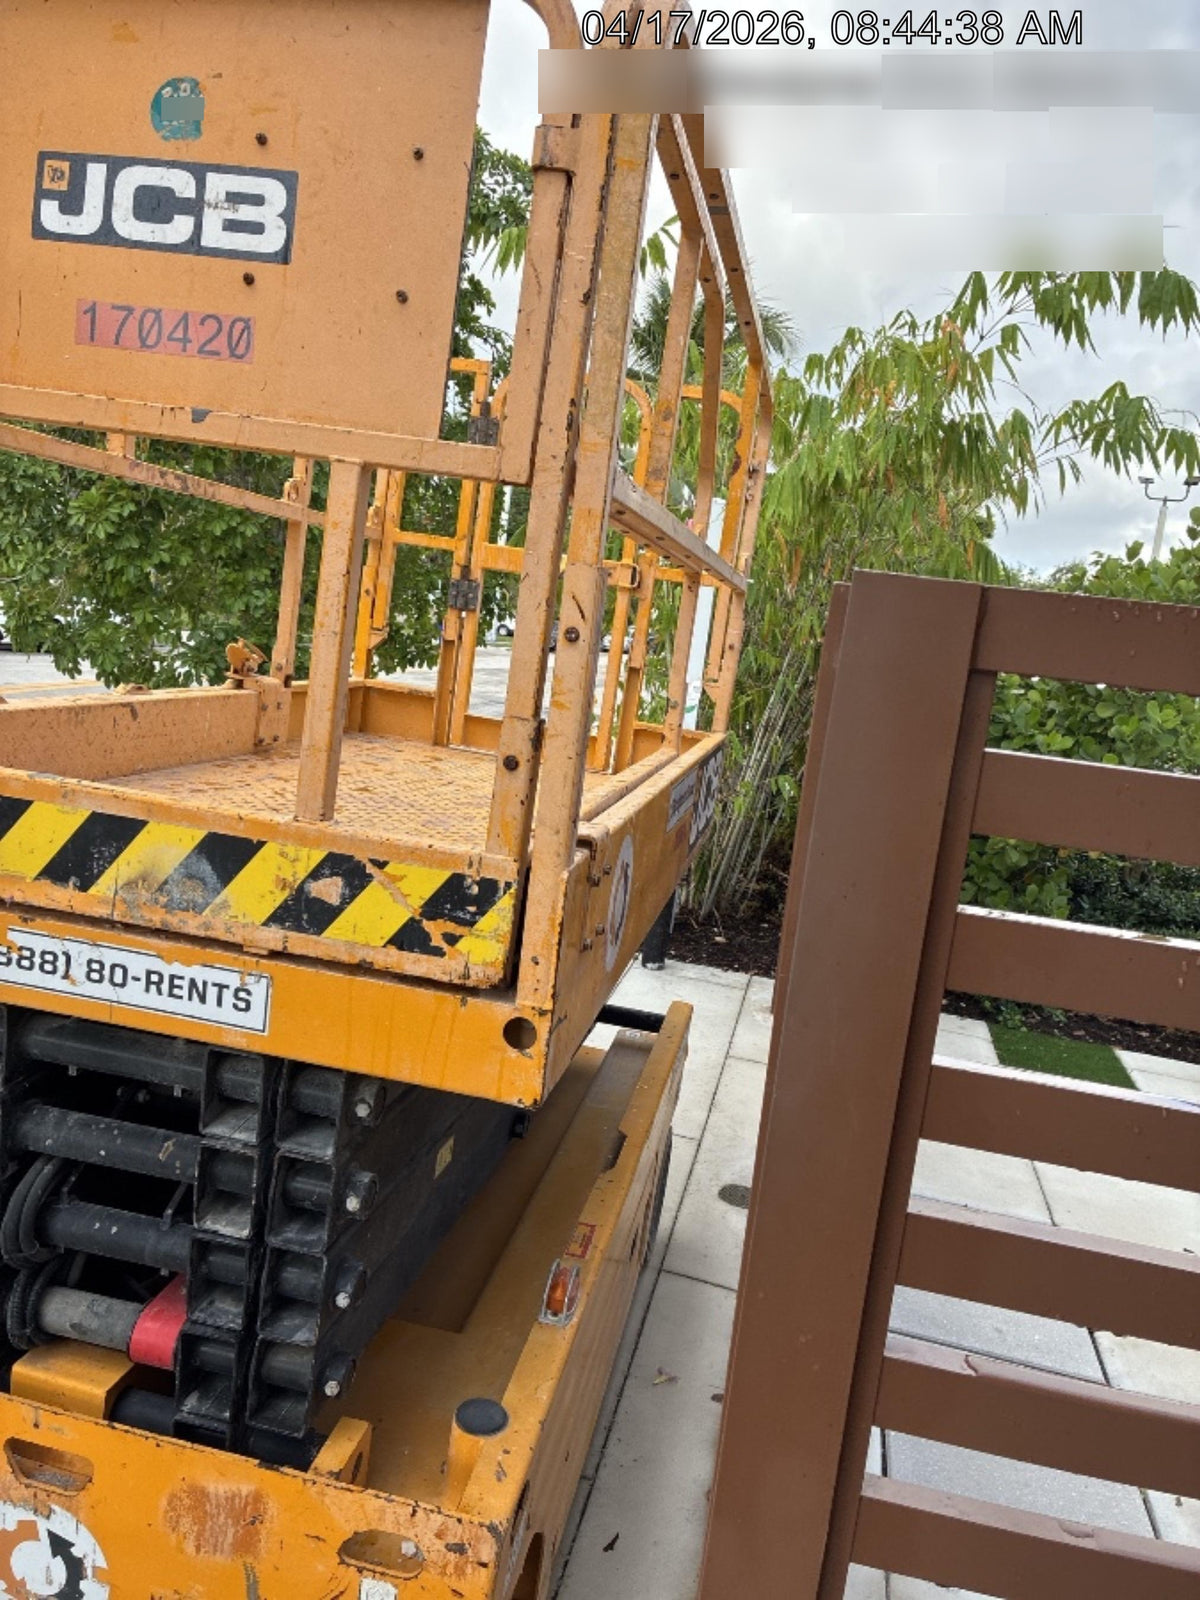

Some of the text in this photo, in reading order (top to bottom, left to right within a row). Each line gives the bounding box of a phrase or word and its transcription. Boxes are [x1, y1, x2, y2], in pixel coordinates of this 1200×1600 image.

[40, 163, 287, 254] JCB
[83, 302, 251, 359] 170420
[85, 957, 252, 1013] 80-RENTS
